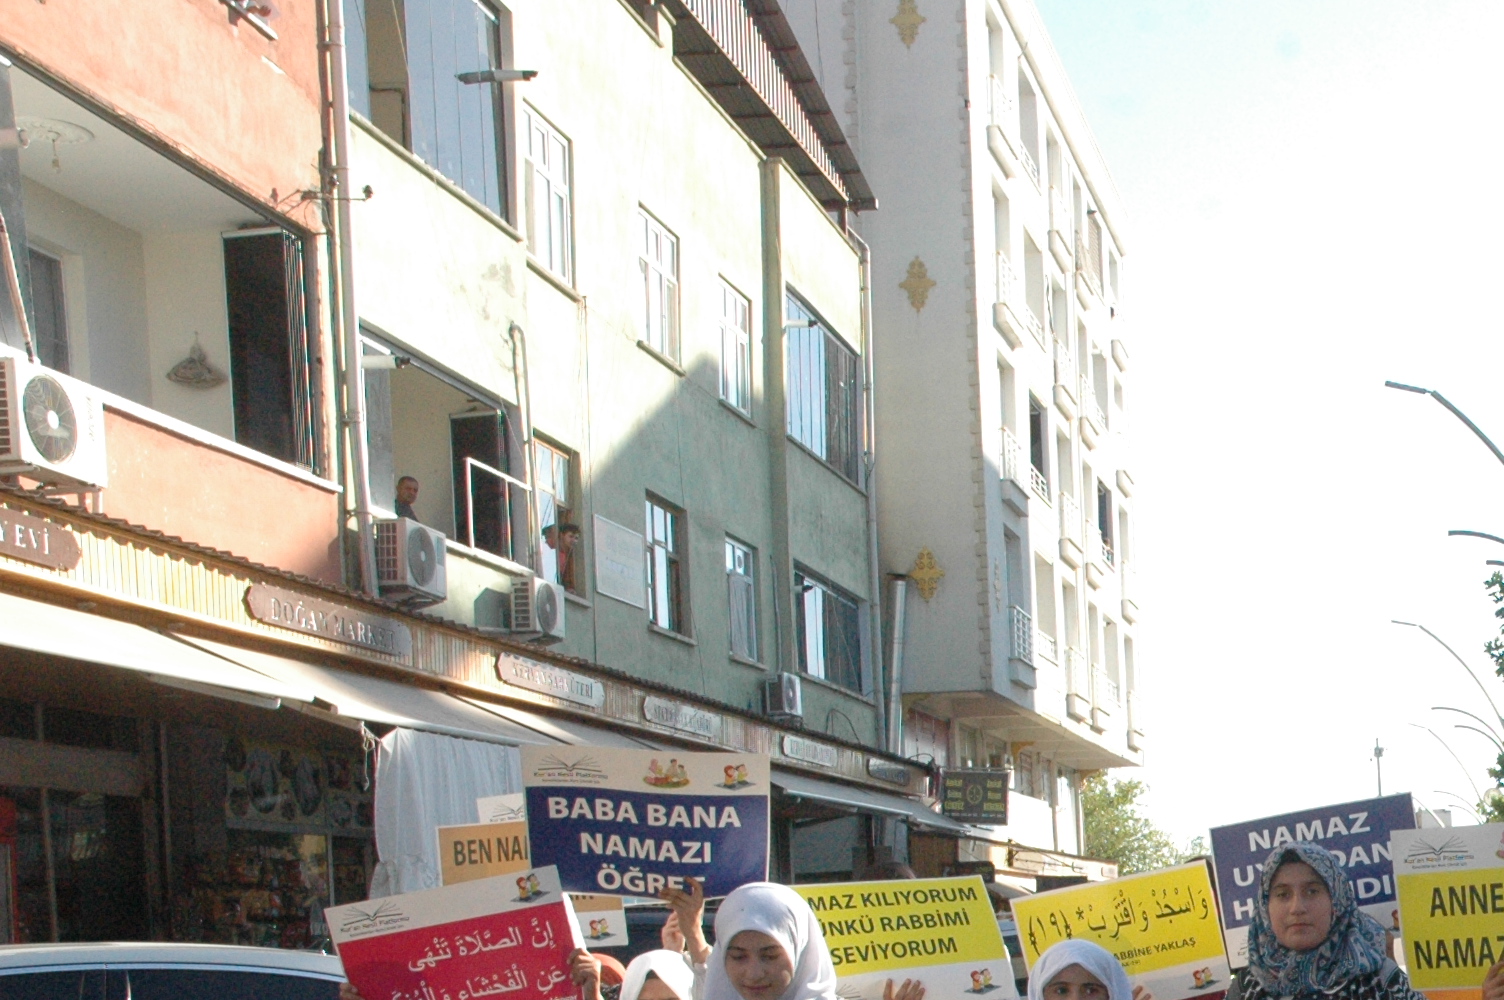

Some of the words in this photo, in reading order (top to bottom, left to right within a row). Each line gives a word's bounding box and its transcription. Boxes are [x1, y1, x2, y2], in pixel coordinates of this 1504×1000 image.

[14, 524, 50, 555] EVİ
[270, 597, 328, 632] DOĞAN
[333, 613, 396, 650] MARKET
[548, 797, 639, 824] BABA
[647, 803, 742, 828] BANA
[1248, 811, 1371, 852] NAMAZ
[453, 839, 492, 867] BEN
[496, 835, 528, 864] NA
[580, 832, 712, 863] NAMAZI
[597, 863, 705, 894] ÖĞRE
[807, 893, 858, 912] MAZ
[860, 886, 978, 907] KILIYORUM
[820, 914, 875, 937] ÜNKÜ
[879, 907, 971, 932] RABBİMİ
[831, 936, 958, 966] SEVİYORUM
[1112, 945, 1152, 961] ABBİNE
[1153, 936, 1197, 954] YAKLAŞ
